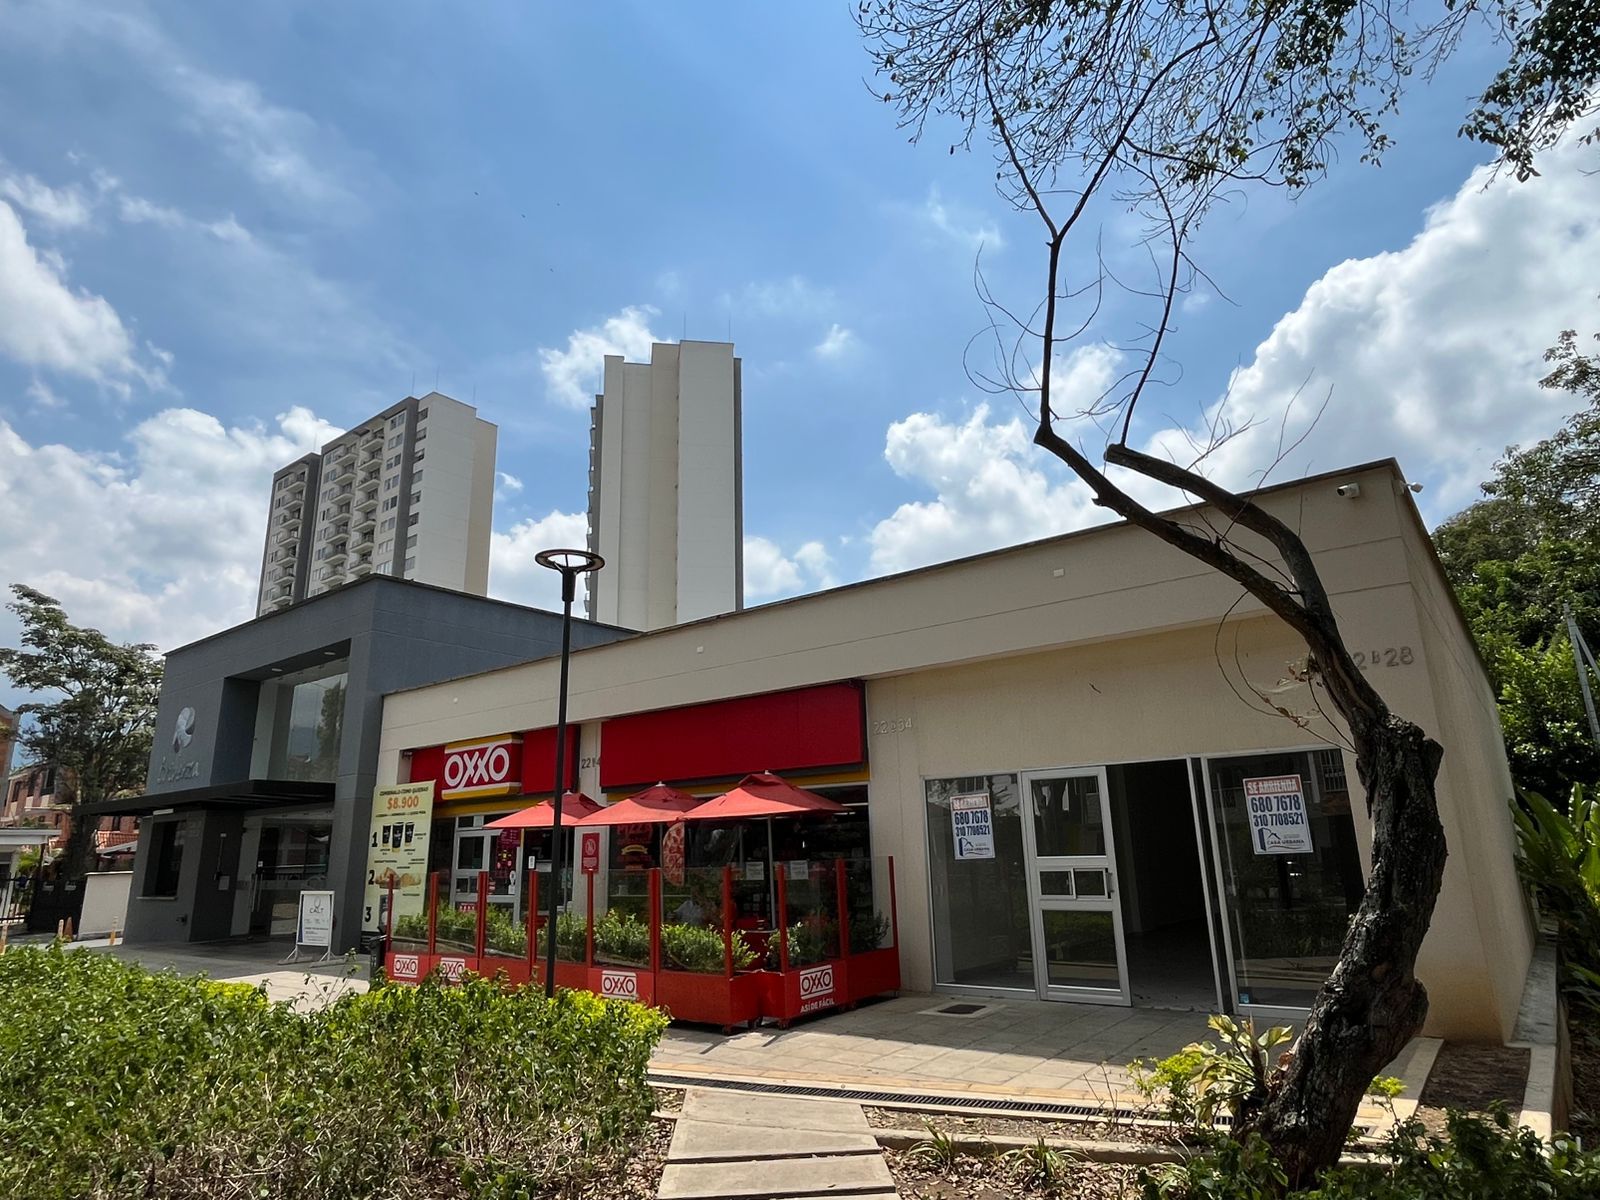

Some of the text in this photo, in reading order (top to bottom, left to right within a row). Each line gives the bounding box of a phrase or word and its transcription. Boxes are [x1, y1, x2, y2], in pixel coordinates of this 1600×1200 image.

[444, 746, 510, 788] OXXO
[1247, 781, 1258, 794] SE
[387, 795, 419, 810] $8.900
[1251, 794, 1301, 813] 680 7678
[955, 810, 989, 825] 680 7678
[1253, 812, 1304, 827] 310 7708521
[371, 831, 378, 847] 1
[955, 826, 966, 837] 310
[368, 869, 375, 885] 2
[364, 906, 372, 922] 3
[395, 959, 417, 973] OXXO
[603, 976, 635, 994] OXXO
[801, 971, 832, 993] OXXO
